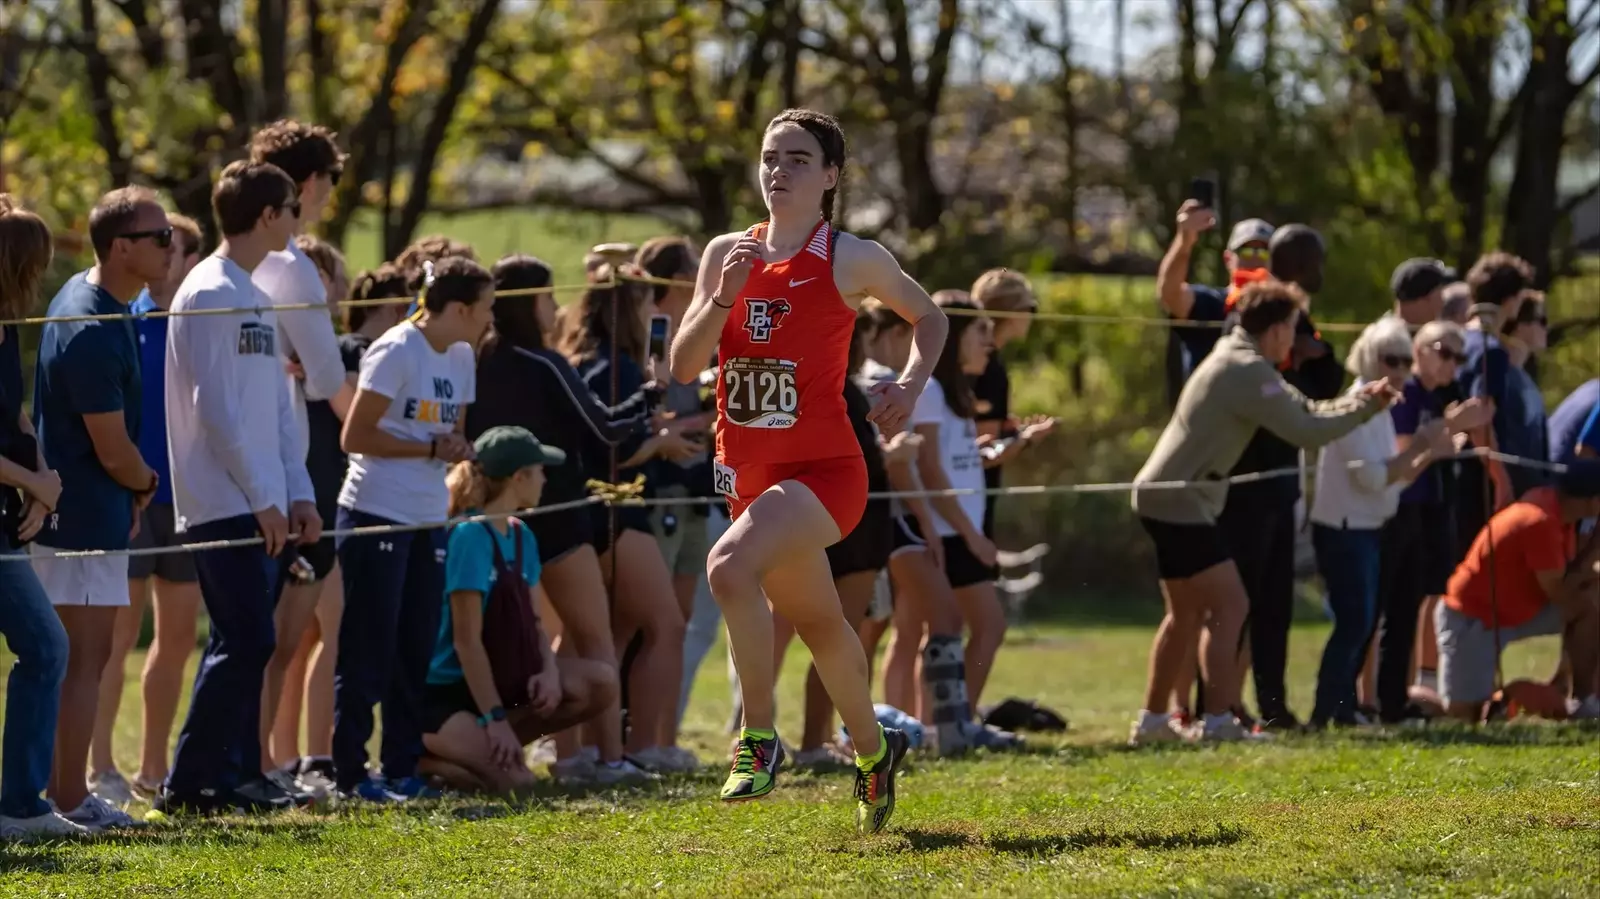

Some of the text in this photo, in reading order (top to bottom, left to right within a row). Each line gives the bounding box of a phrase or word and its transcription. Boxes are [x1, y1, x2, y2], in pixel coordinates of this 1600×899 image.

[433, 376, 453, 399] NO
[725, 370, 797, 412] 2126
[715, 469, 732, 494] 26
